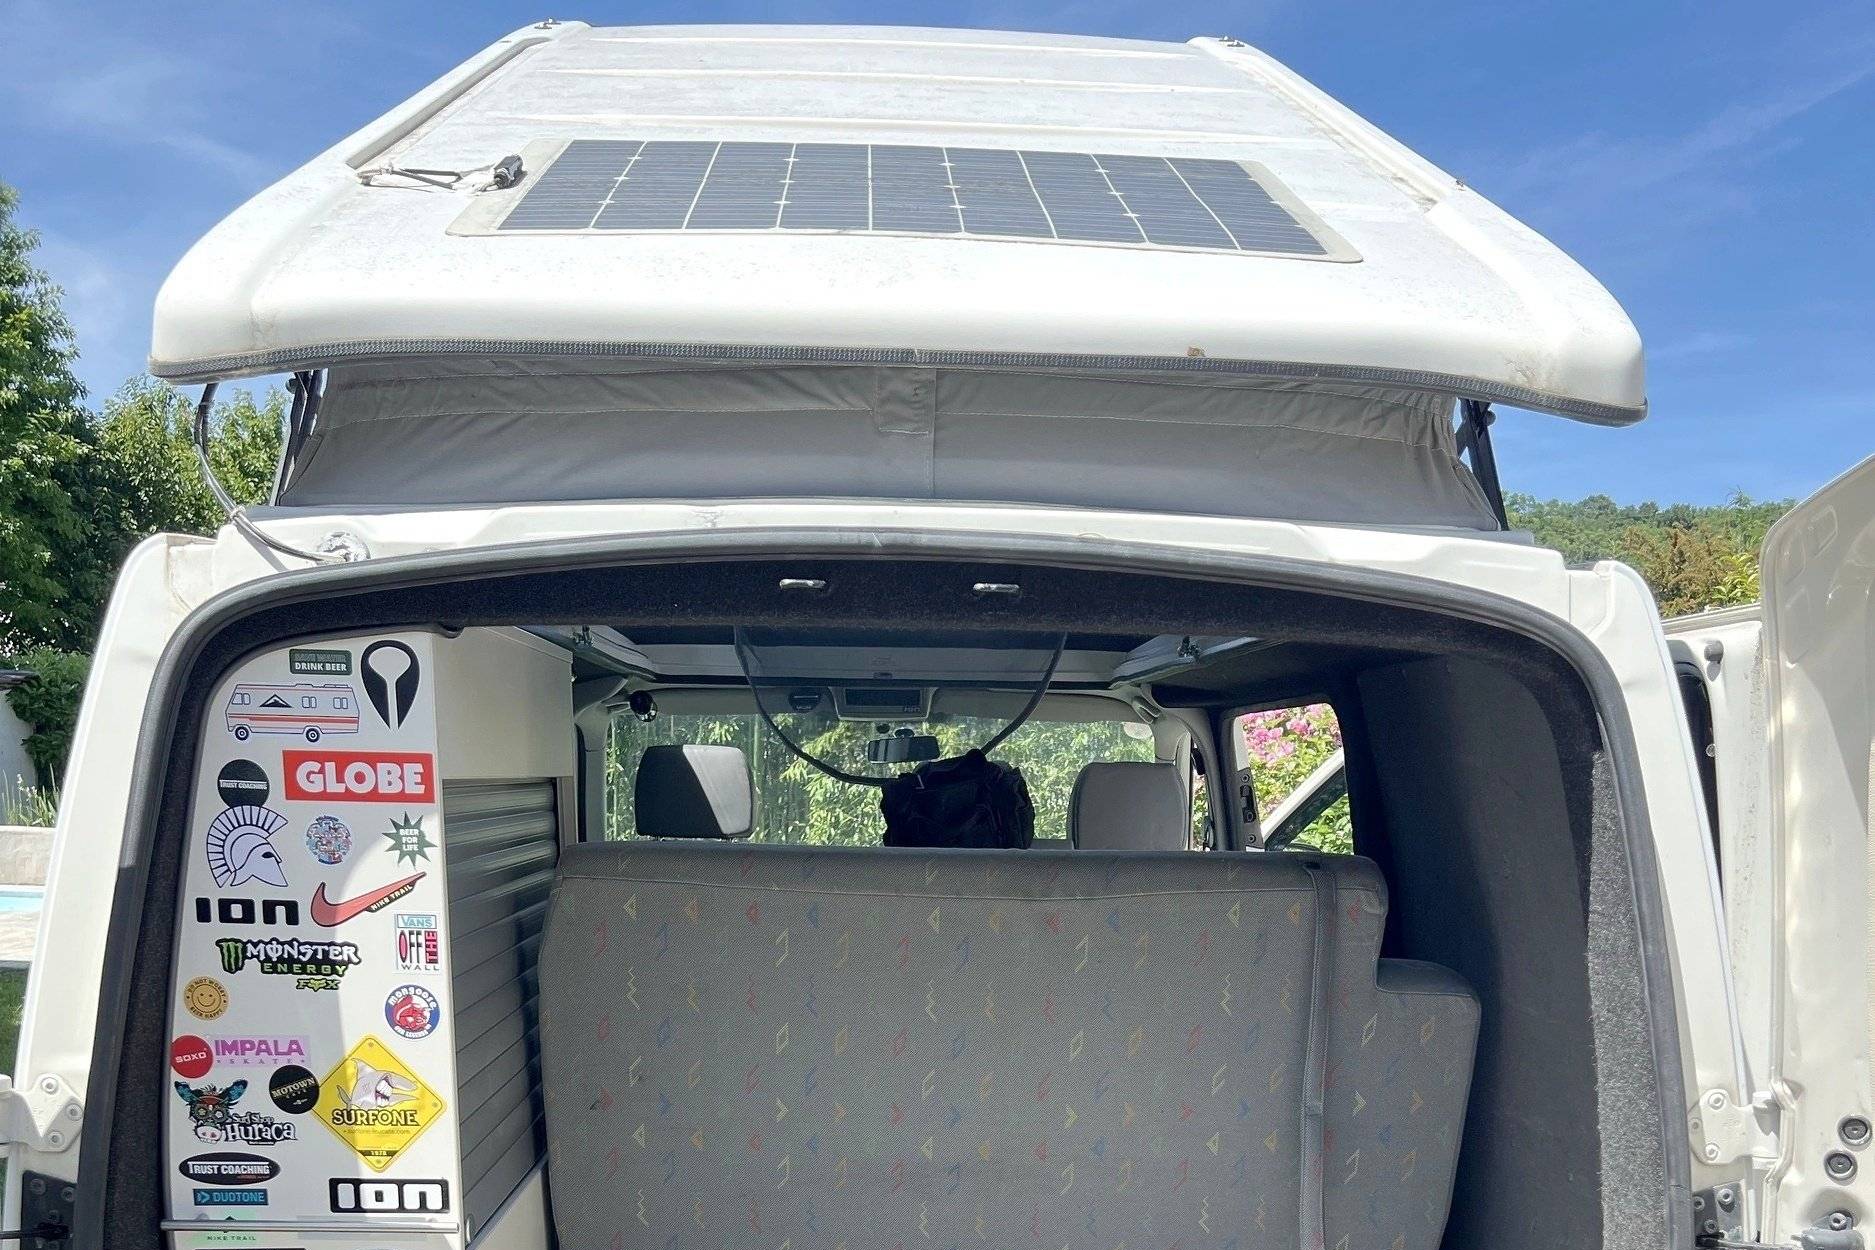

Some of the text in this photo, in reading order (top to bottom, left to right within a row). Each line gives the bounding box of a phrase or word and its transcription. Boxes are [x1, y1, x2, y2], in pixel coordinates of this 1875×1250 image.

[295, 662, 347, 671] DRINK BEER
[219, 780, 238, 788] TRUST
[296, 760, 425, 794] GLOBE
[399, 828, 419, 836] BEER
[371, 884, 413, 911] NIKE TRAIL
[401, 915, 433, 928] VANS
[245, 941, 361, 963] MONSTER
[399, 930, 438, 964] OFF THE
[263, 962, 347, 975] ENERGY
[388, 986, 437, 1011] mongoose
[215, 1039, 304, 1056] IMPALA
[271, 1077, 316, 1099] MOTOWN
[232, 1112, 275, 1125] Surf Shop
[332, 1108, 420, 1126] SURFONE
[187, 1161, 270, 1174] TRUST COACHING
[212, 1192, 265, 1202] DUOTONE
